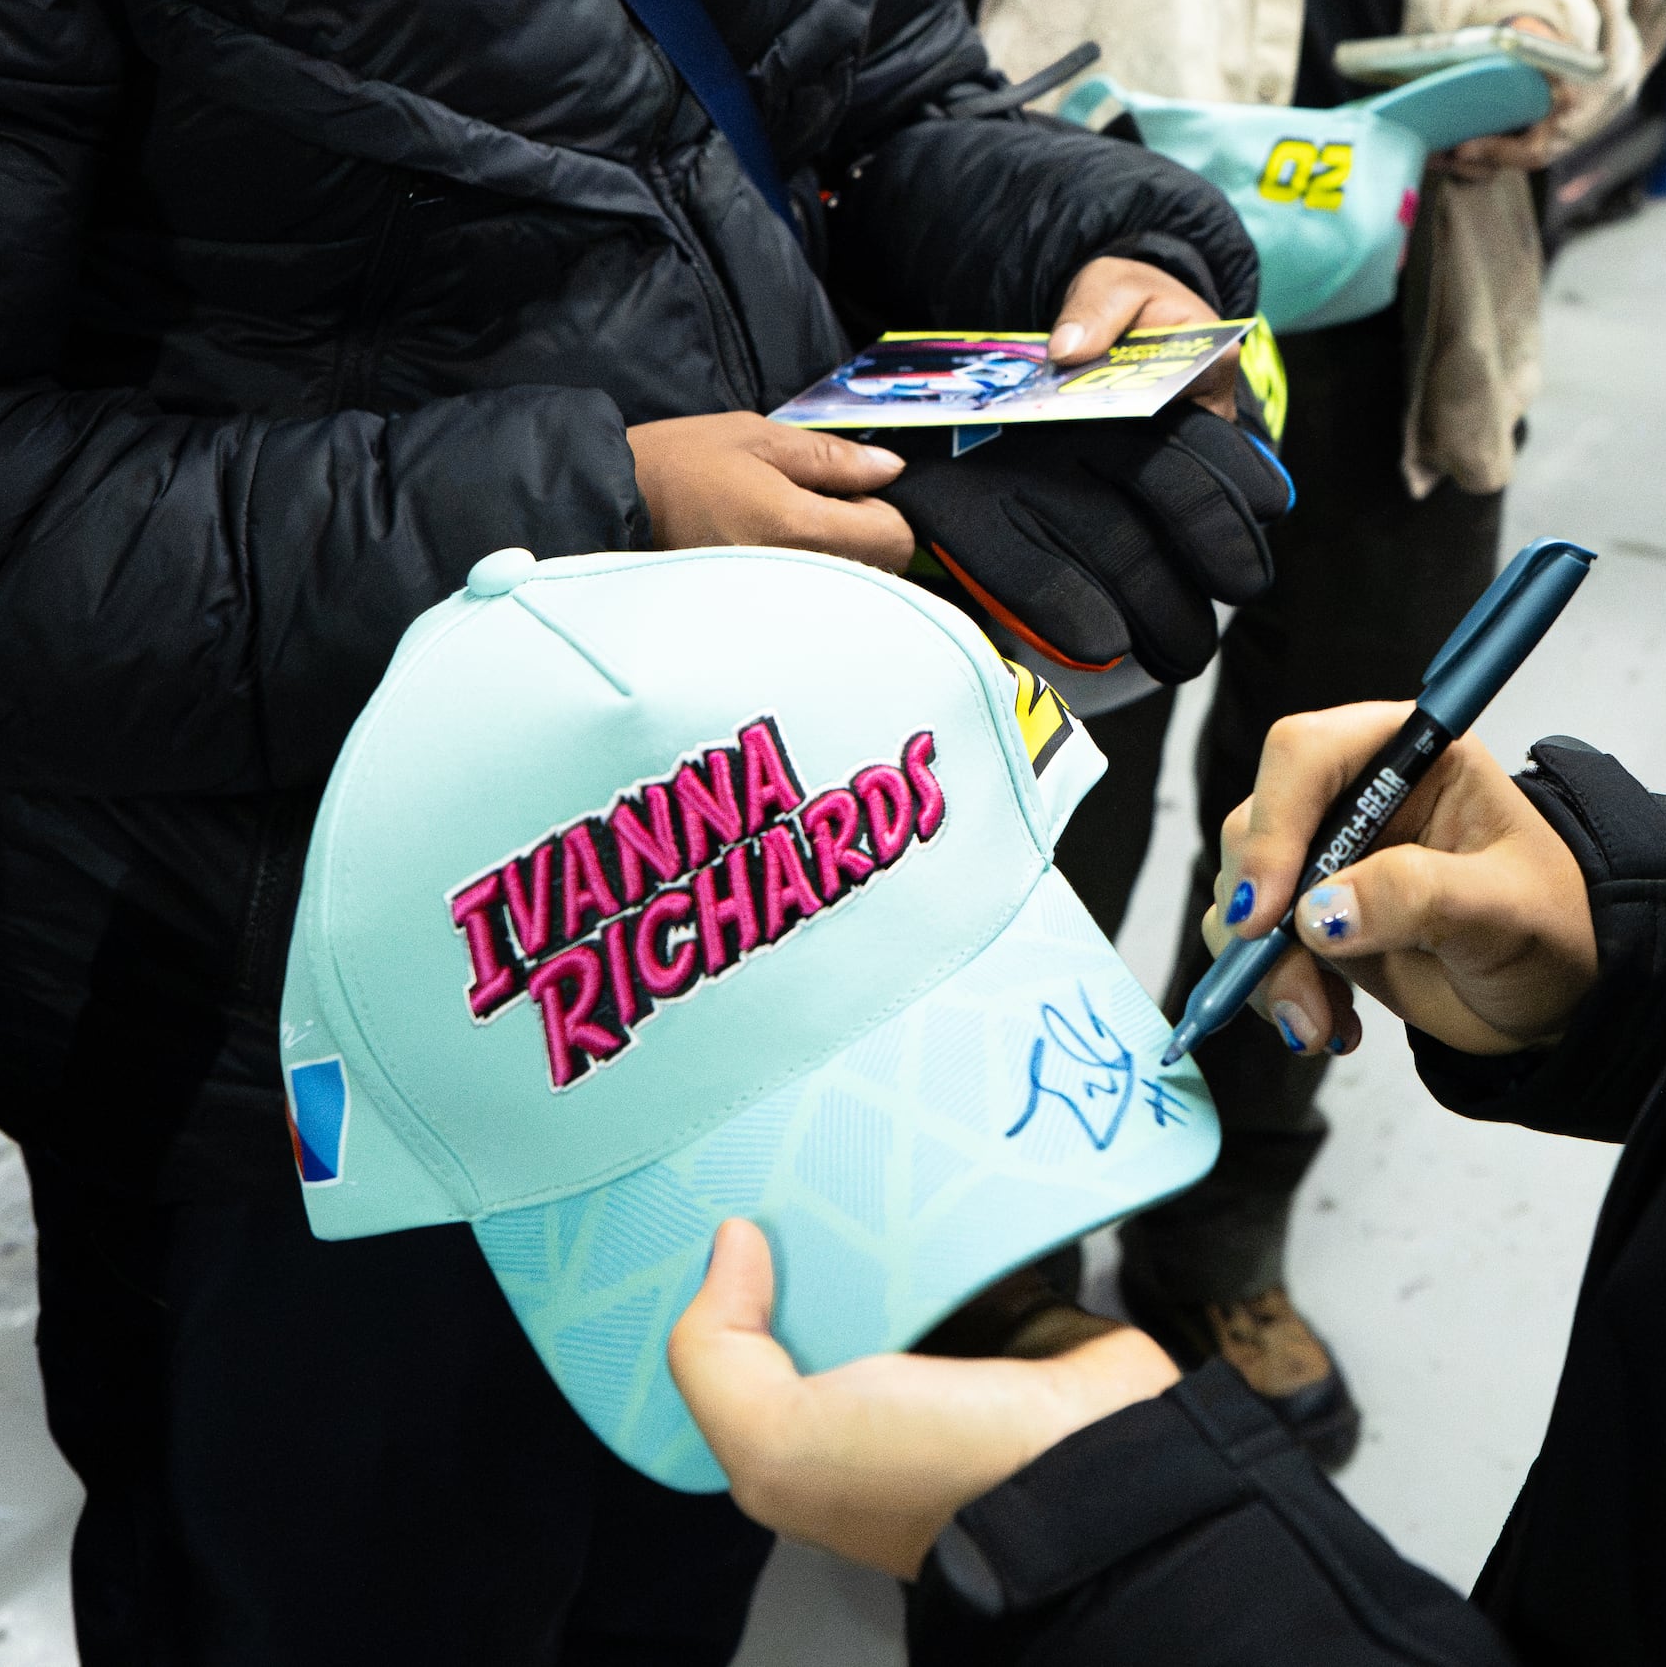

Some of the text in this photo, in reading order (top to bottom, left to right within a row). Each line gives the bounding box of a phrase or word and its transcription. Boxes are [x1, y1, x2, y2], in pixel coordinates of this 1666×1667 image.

[1257, 137, 1354, 214] 02
[450, 713, 808, 1022] IVANNA
[525, 726, 949, 1090] RICHARDS
